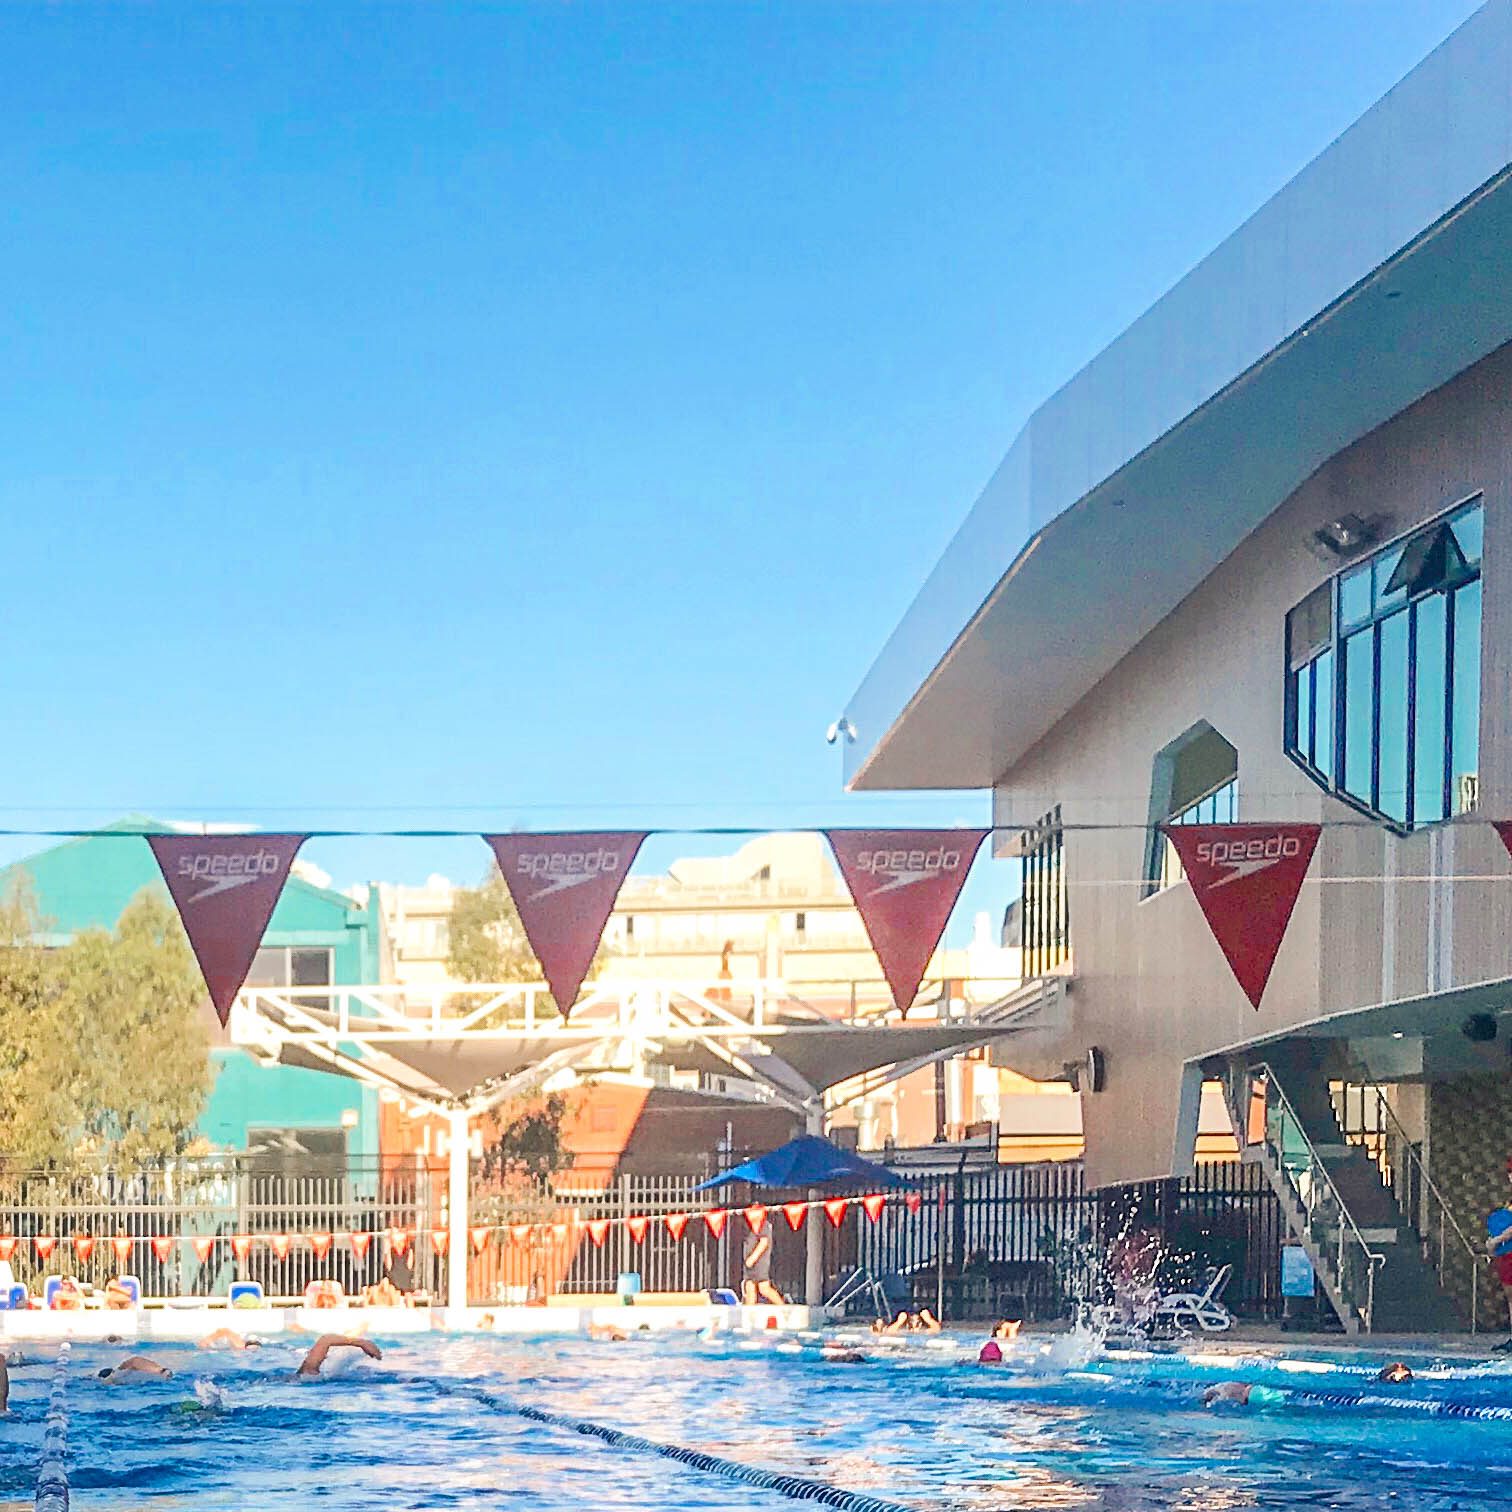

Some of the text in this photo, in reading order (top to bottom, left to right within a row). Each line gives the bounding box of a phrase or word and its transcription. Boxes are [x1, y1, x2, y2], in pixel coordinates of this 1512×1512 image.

[178, 849, 278, 880] speedo
[517, 848, 618, 878] speedo
[856, 846, 960, 874] speedo
[1196, 834, 1300, 867] speedo
